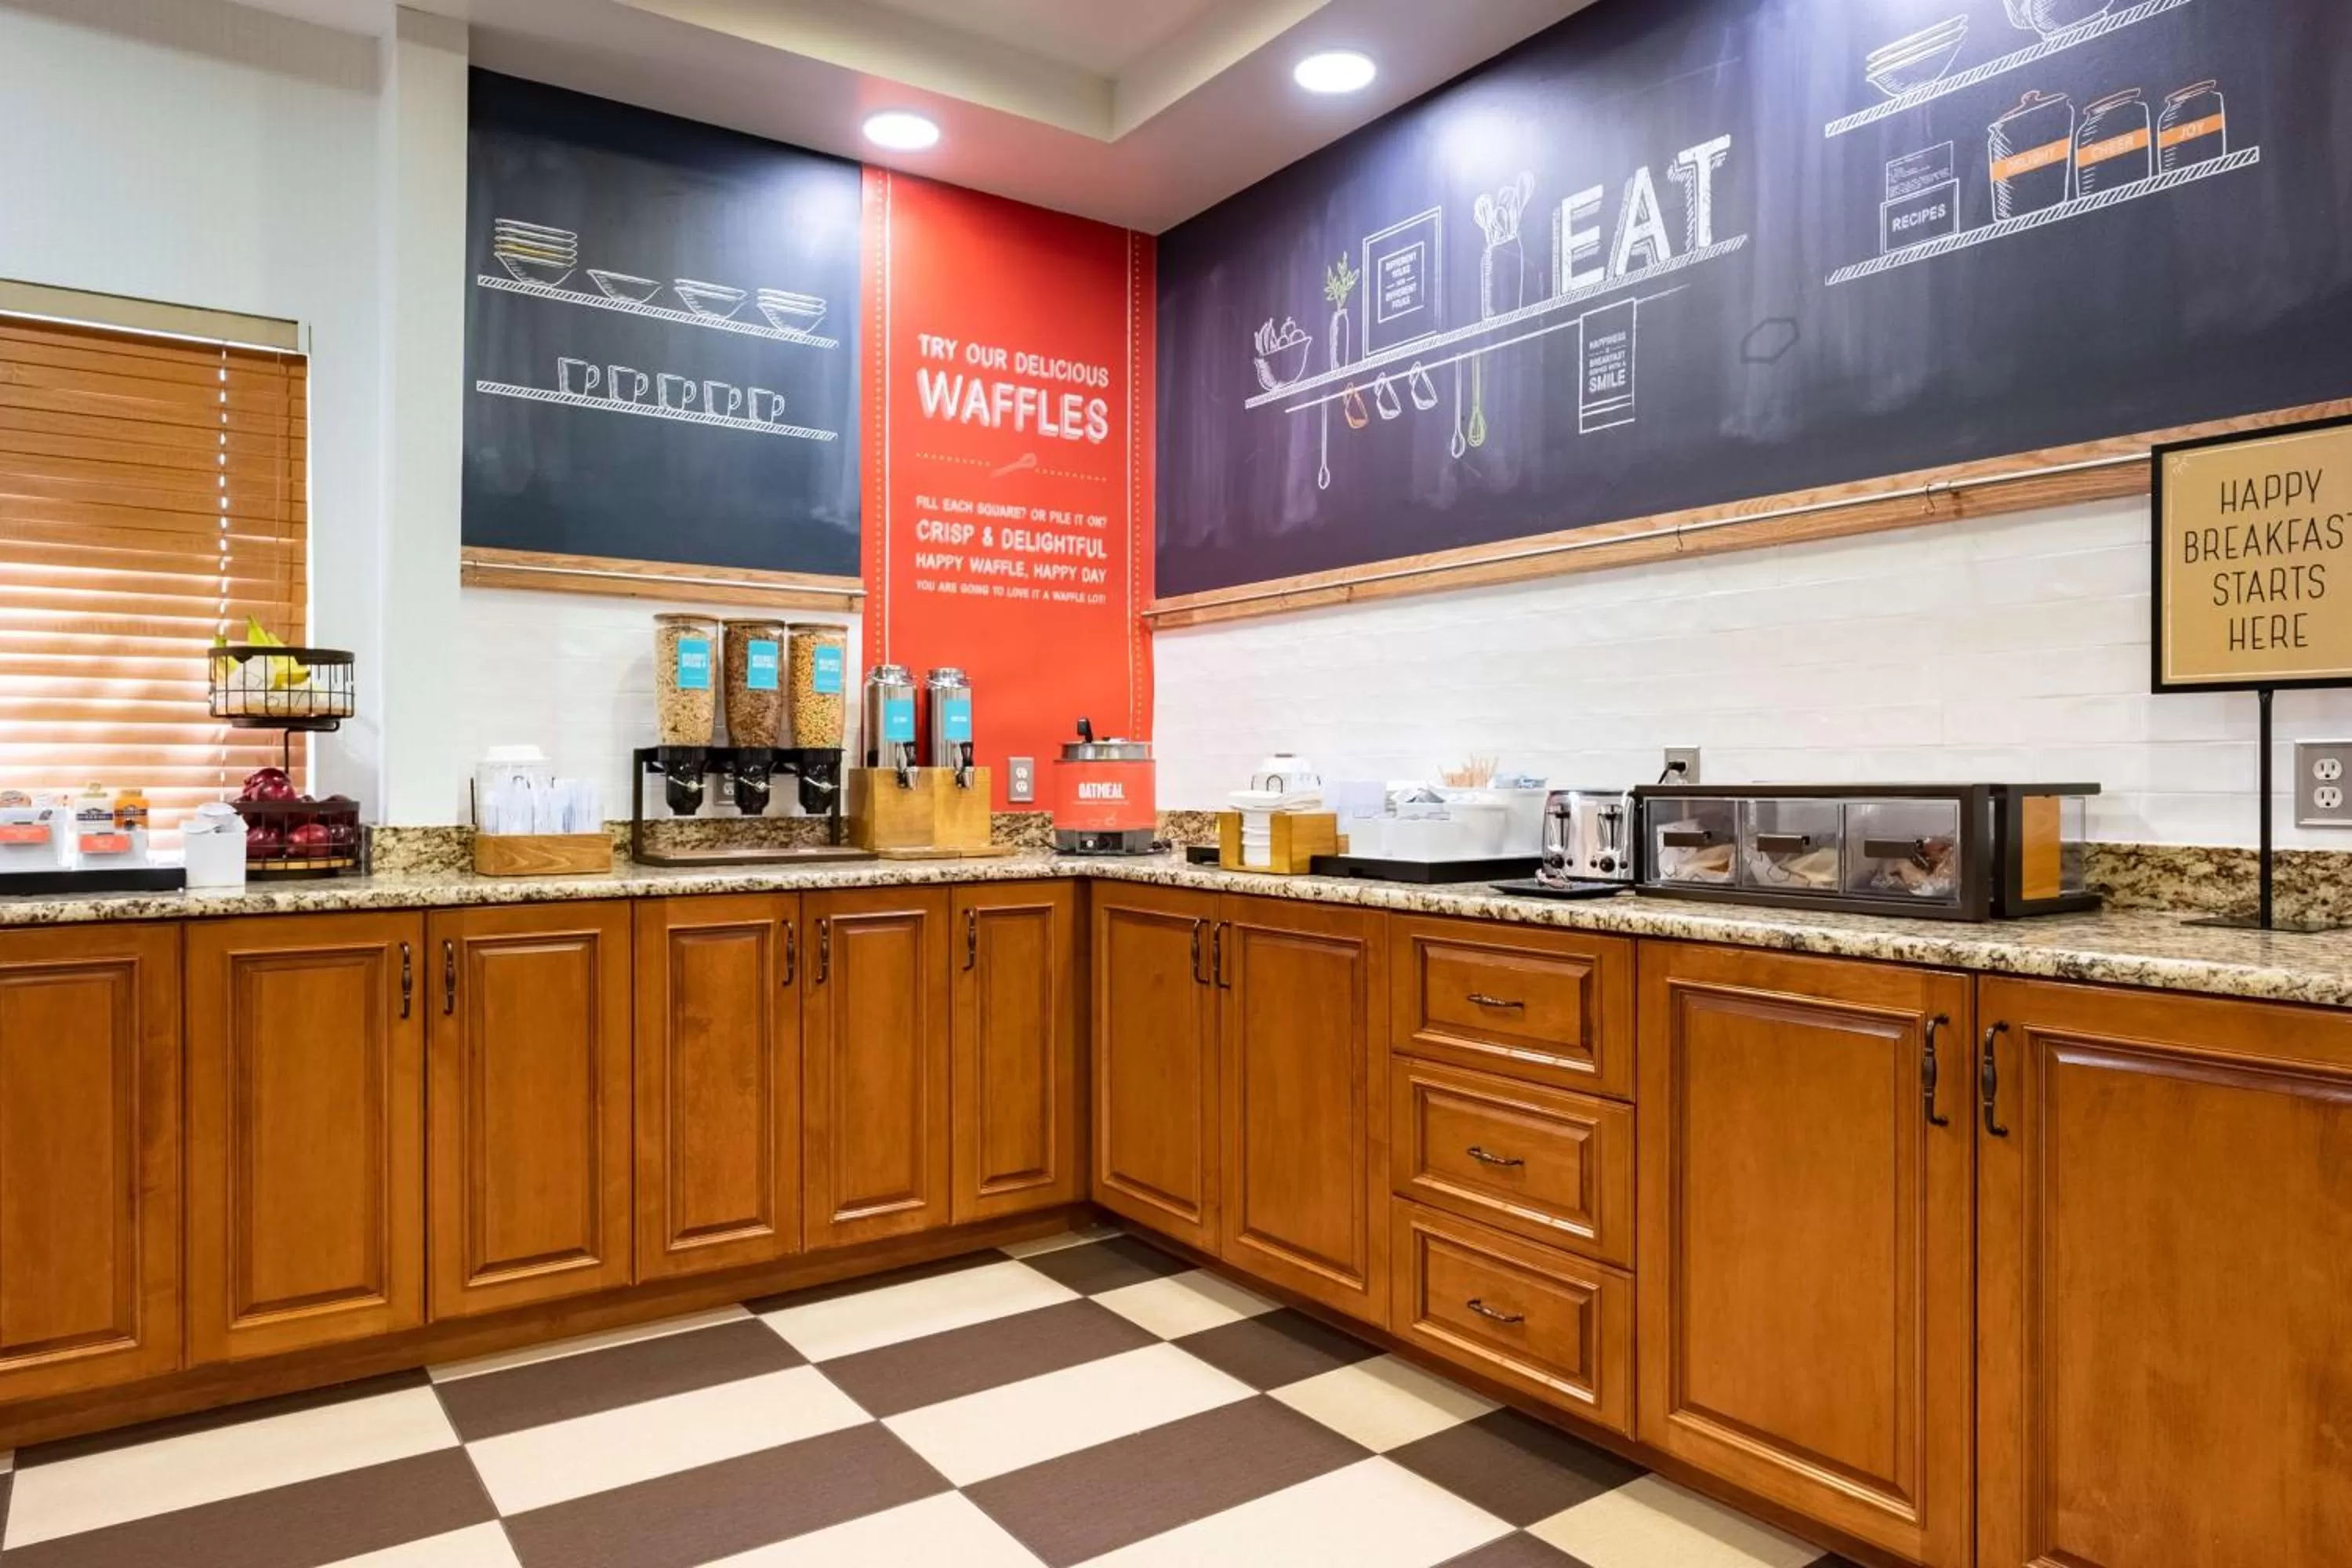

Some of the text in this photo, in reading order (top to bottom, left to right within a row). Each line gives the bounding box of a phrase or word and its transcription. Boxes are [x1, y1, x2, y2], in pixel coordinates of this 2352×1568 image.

[2091, 136, 2133, 158] CHEER
[2181, 122, 2205, 139] JOY
[1552, 134, 1731, 296] EAT
[1892, 203, 1946, 233] RECIPES
[918, 333, 1109, 388] TRY OUR DELICIOUS
[1589, 368, 1625, 393] SMILE
[916, 367, 1109, 445] WAFFLES
[2221, 468, 2323, 514] HAPPY
[916, 495, 938, 510] FILL
[943, 498, 973, 514] EACH
[1030, 510, 1046, 521] OR
[1049, 510, 1072, 524] PILE
[1074, 513, 1083, 525] IT
[916, 518, 1108, 559] CRISP & DELIGHTFUL
[916, 552, 964, 571] HAPPY
[1034, 564, 1077, 583] HAPPY
[1082, 567, 1107, 585] DAY
[2213, 564, 2326, 606] STARTS
[916, 579, 935, 591] YOU
[938, 581, 957, 593] ARE
[960, 583, 989, 596] GOING
[993, 585, 1004, 597] TO
[1007, 586, 1029, 599] LOVE
[1033, 588, 1040, 600] IT
[1043, 590, 1049, 601] A
[1053, 590, 1085, 603] WAFFLE
[2229, 612, 2308, 651] HERE
[1079, 782, 1125, 800] OATMEAL
